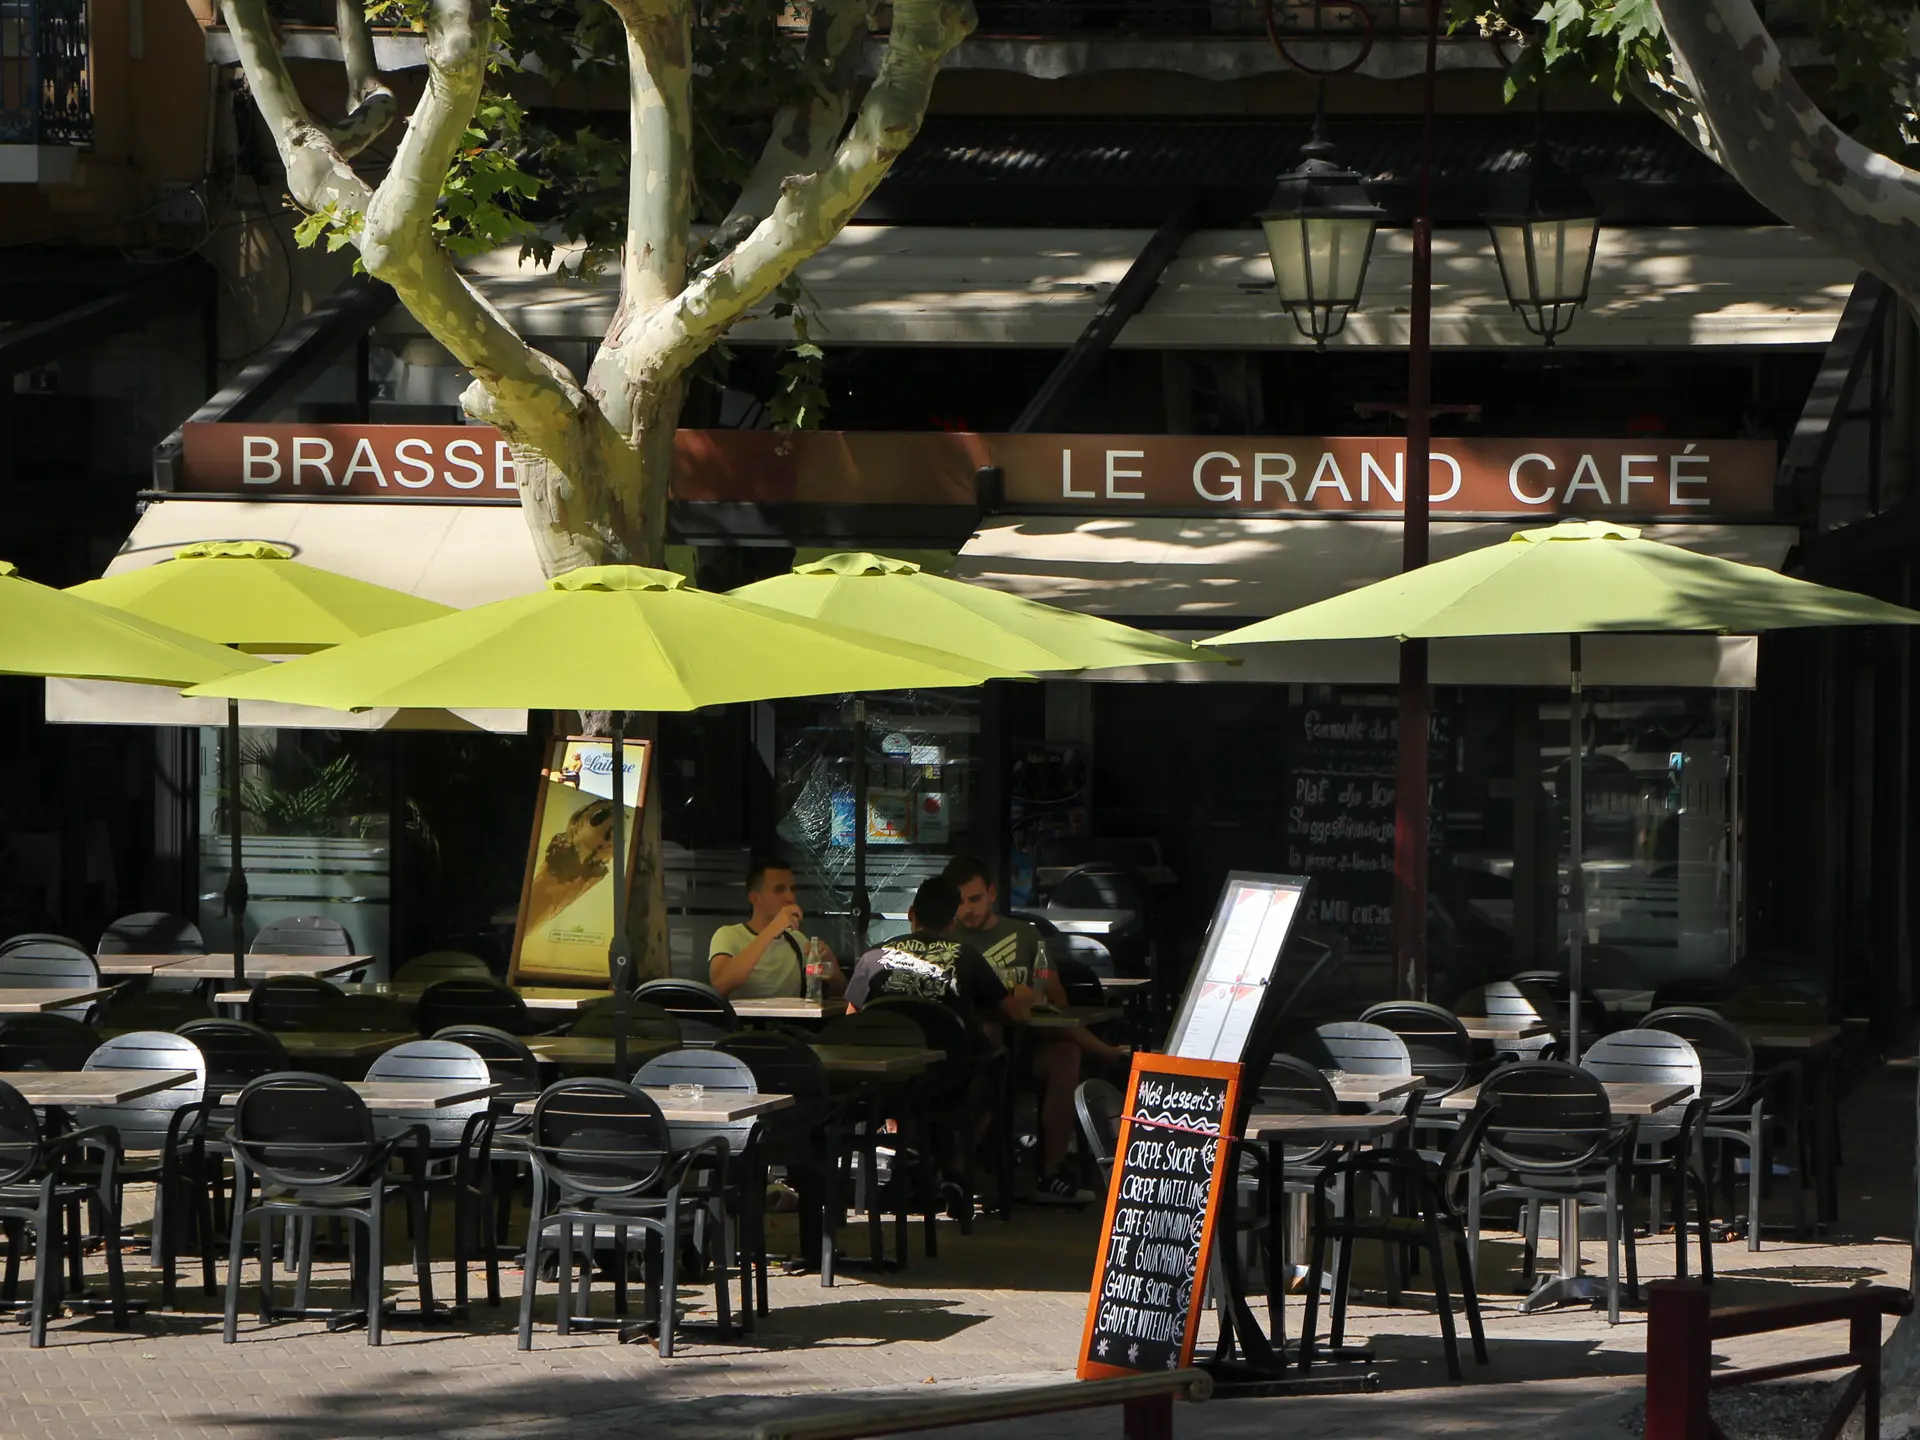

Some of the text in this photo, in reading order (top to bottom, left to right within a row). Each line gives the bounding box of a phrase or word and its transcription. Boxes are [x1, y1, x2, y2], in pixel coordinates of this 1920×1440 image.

[1062, 444, 1711, 506] LE GRAND CAFÉ
[1296, 778, 1331, 806] Plat
[1141, 1081, 1216, 1112] Nos desserts
[1127, 1140, 1164, 1170] CREPE
[1163, 1140, 1199, 1174] SUCRE
[1122, 1174, 1158, 1203] CREPE
[1115, 1207, 1144, 1235] CAFE
[1142, 1209, 1191, 1241] GOURMAND
[1108, 1235, 1132, 1267] THE
[1135, 1237, 1185, 1278] GOURMAND
[1104, 1270, 1144, 1303] GAUFRE
[1143, 1277, 1173, 1308] SUCRE
[1098, 1301, 1138, 1338] GAUFRE
[1135, 1310, 1173, 1342] NUTELLA
